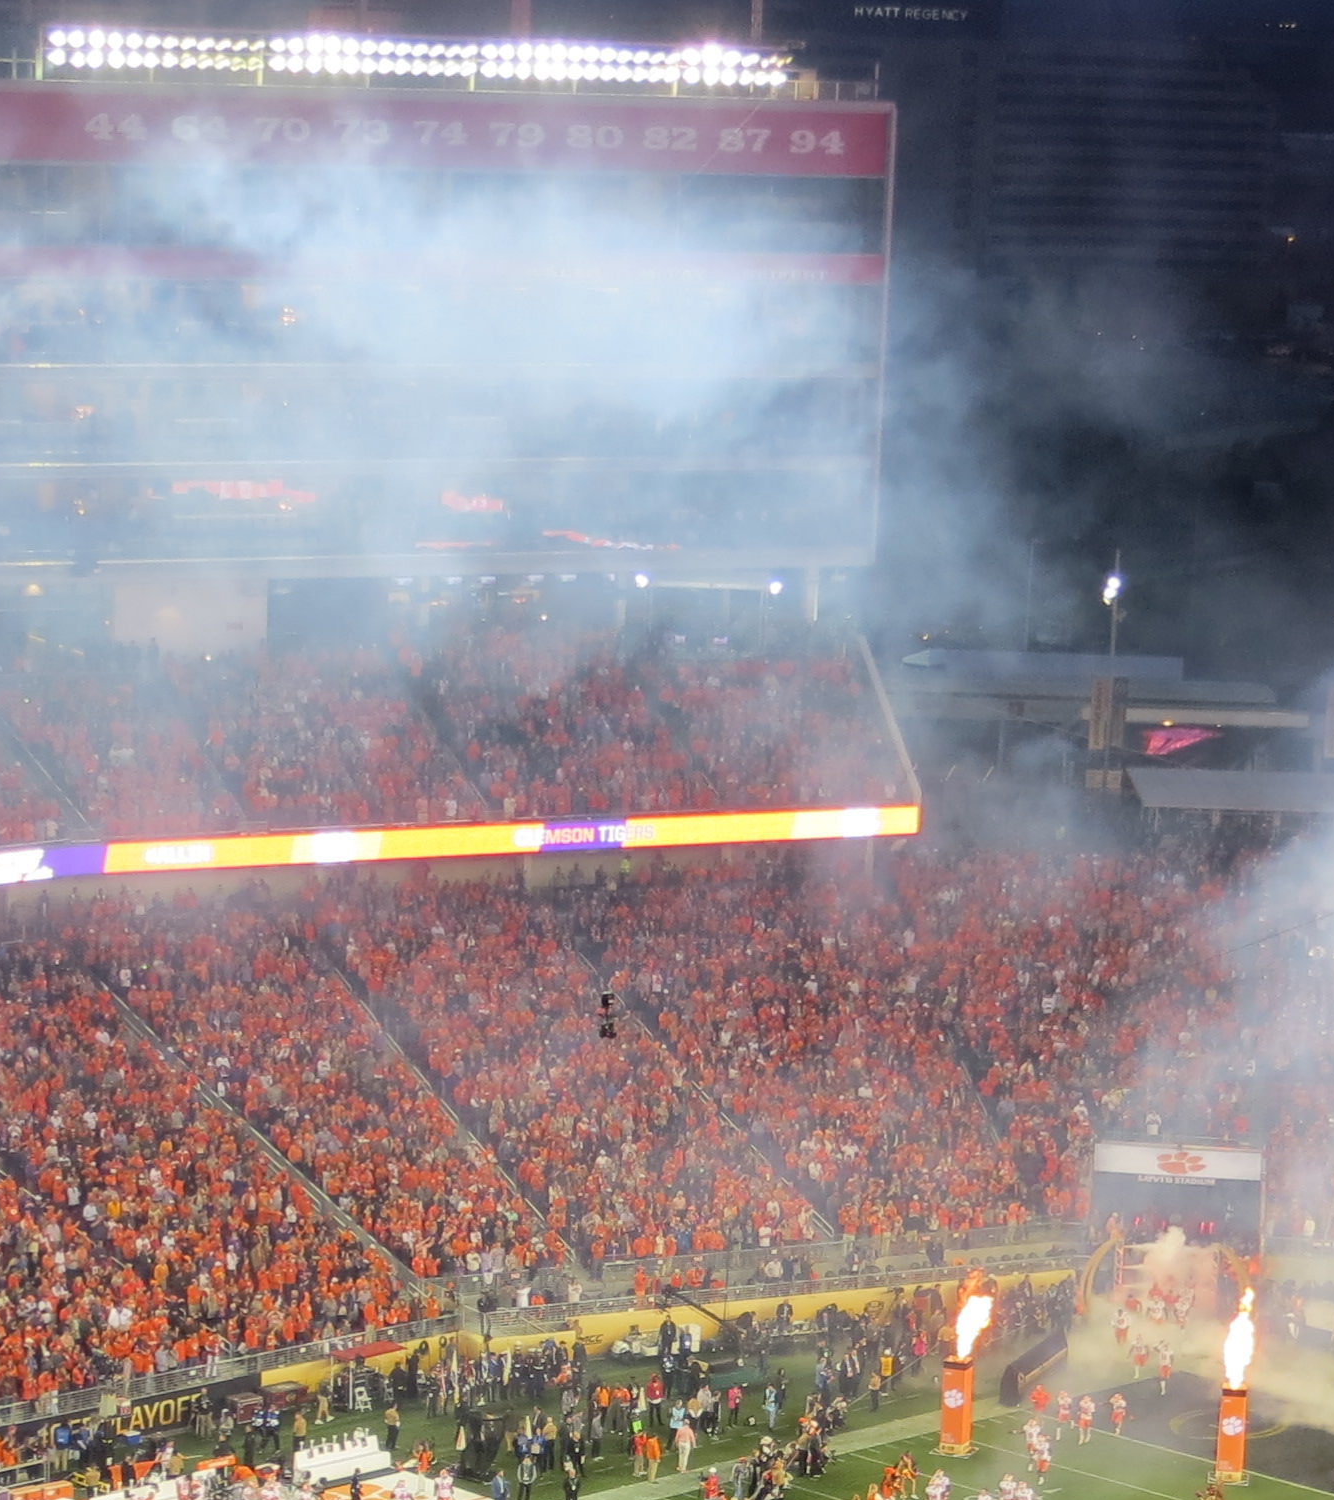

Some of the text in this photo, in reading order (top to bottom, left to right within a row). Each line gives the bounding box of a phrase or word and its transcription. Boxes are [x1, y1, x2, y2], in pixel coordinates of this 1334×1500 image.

[854, 6, 969, 22] HYATT REGENCY
[84, 113, 147, 141] 44
[253, 117, 311, 143] 70
[414, 120, 467, 146] 74
[490, 121, 545, 148] 79
[566, 123, 623, 149] 80
[642, 124, 697, 151] 82
[718, 126, 772, 153] 87
[789, 128, 846, 155] 94
[514, 824, 654, 847] CLEMSON TIGERS
[112, 1393, 201, 1435] LAYOF
